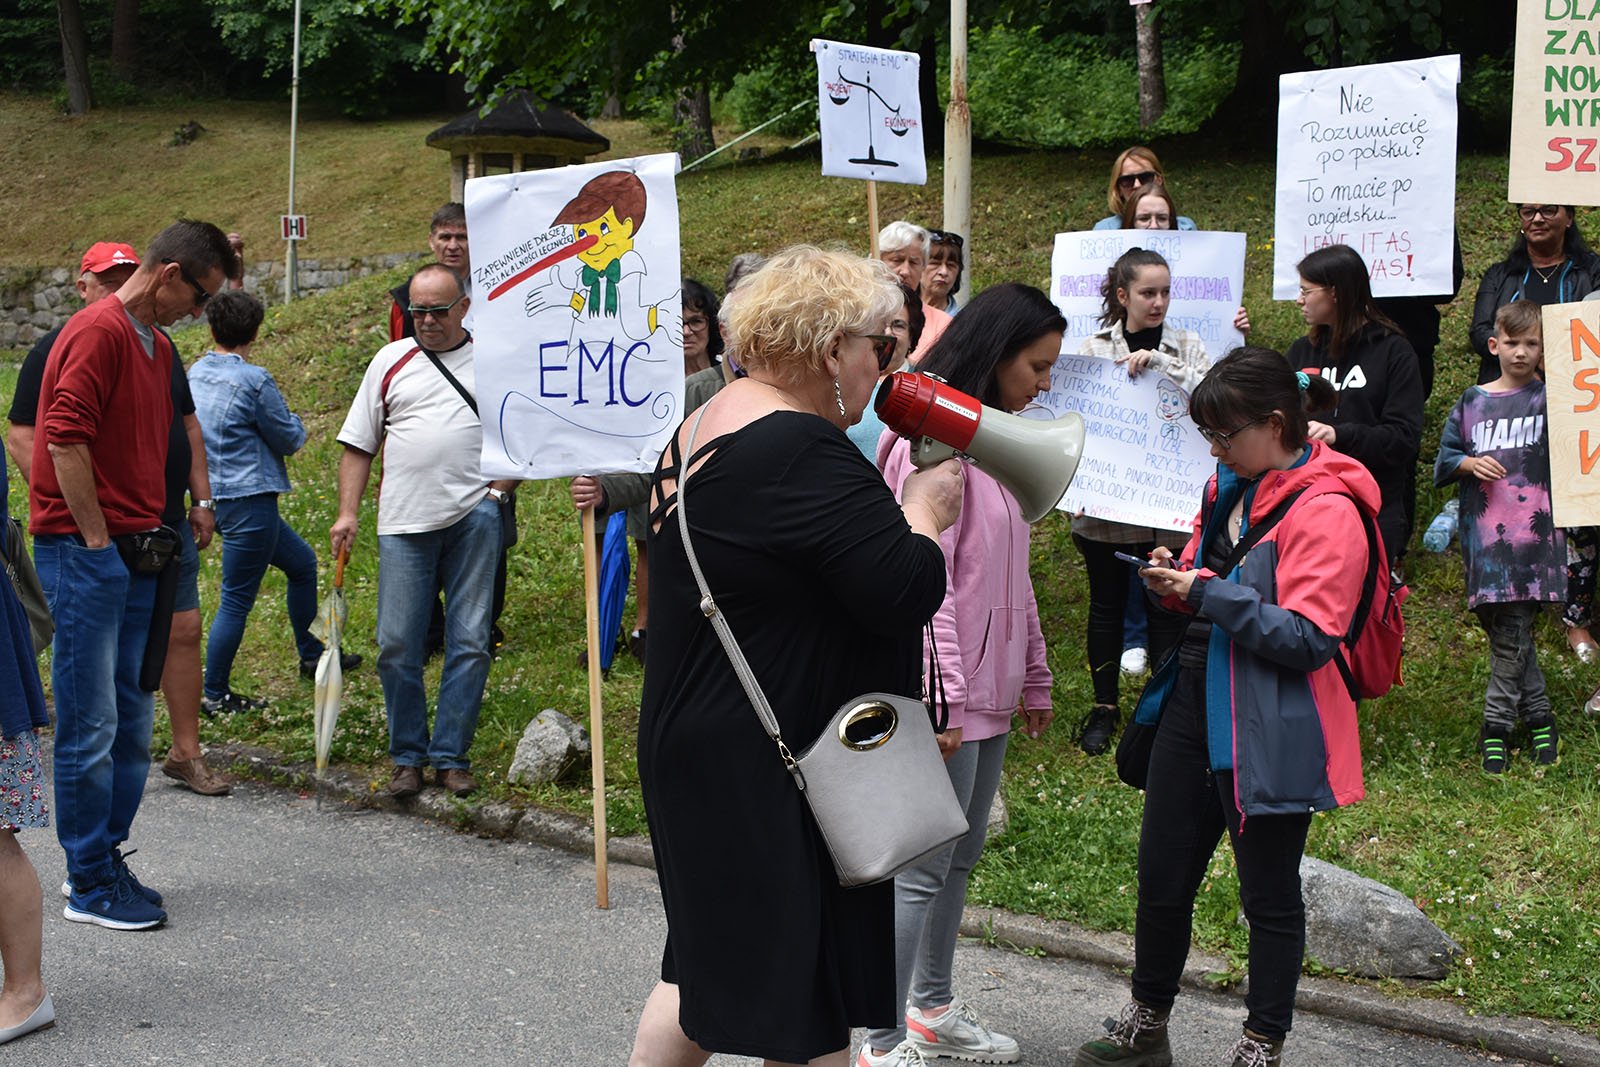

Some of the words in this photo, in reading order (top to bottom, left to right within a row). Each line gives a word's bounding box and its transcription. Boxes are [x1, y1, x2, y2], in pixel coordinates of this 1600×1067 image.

[1544, 30, 1600, 55] ZA
[838, 49, 878, 64] STRATEGIA
[881, 54, 900, 70] EMC
[1340, 83, 1374, 115] Nie
[1300, 113, 1429, 143] Rozumiecie
[1316, 150, 1345, 174] po
[1349, 135, 1424, 171] polsku?
[1545, 137, 1600, 172] SZ
[1298, 178, 1325, 203] To
[1330, 177, 1387, 201] macie
[1391, 178, 1413, 206] po
[473, 240, 534, 283] ZAPEWNIENIE
[533, 225, 567, 247] DALSZEJ
[538, 234, 574, 257] LECZNICZEJ
[1361, 232, 1383, 254] IT
[1385, 231, 1412, 253] AS
[1060, 274, 1109, 297] PACJE
[1169, 275, 1233, 302] KONOMIA
[540, 336, 653, 407] EMC
[1125, 467, 1162, 488] PINOKIO
